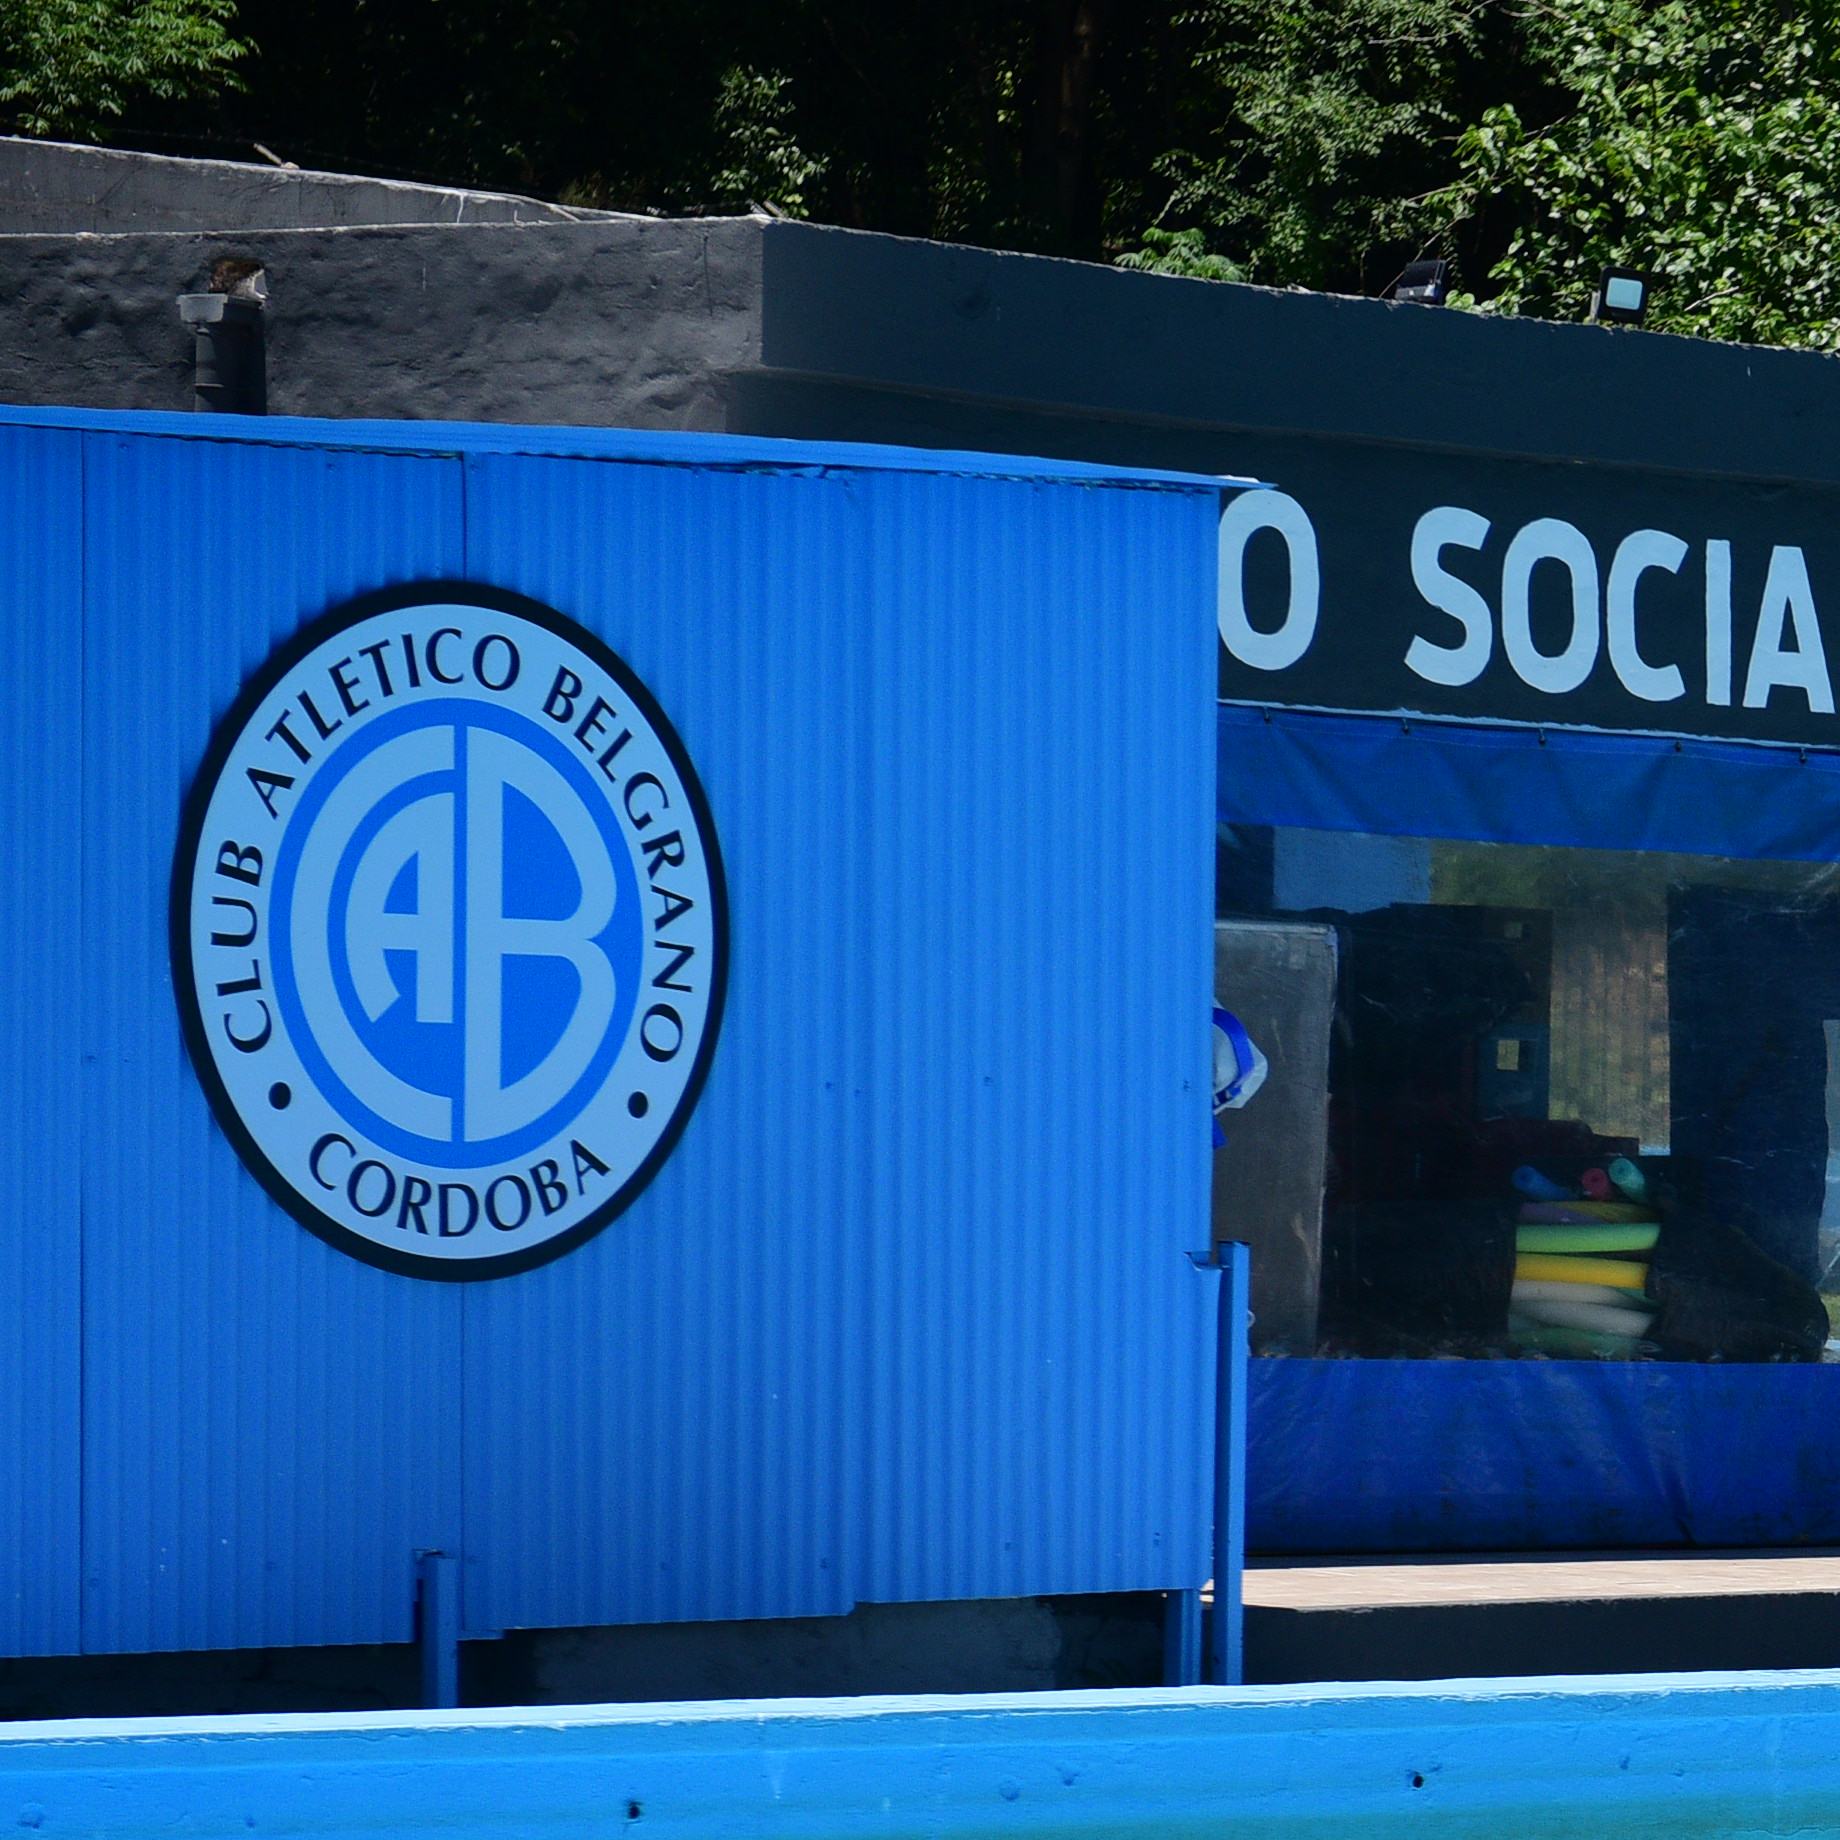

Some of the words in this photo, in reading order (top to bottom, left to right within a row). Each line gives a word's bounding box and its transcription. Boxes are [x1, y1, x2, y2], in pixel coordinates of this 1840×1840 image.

[211, 839, 265, 1053] CLUB
[245, 627, 520, 819] ATLETICO
[542, 664, 695, 1063] BELGRANO
[308, 1132, 611, 1237] CORDOBA
